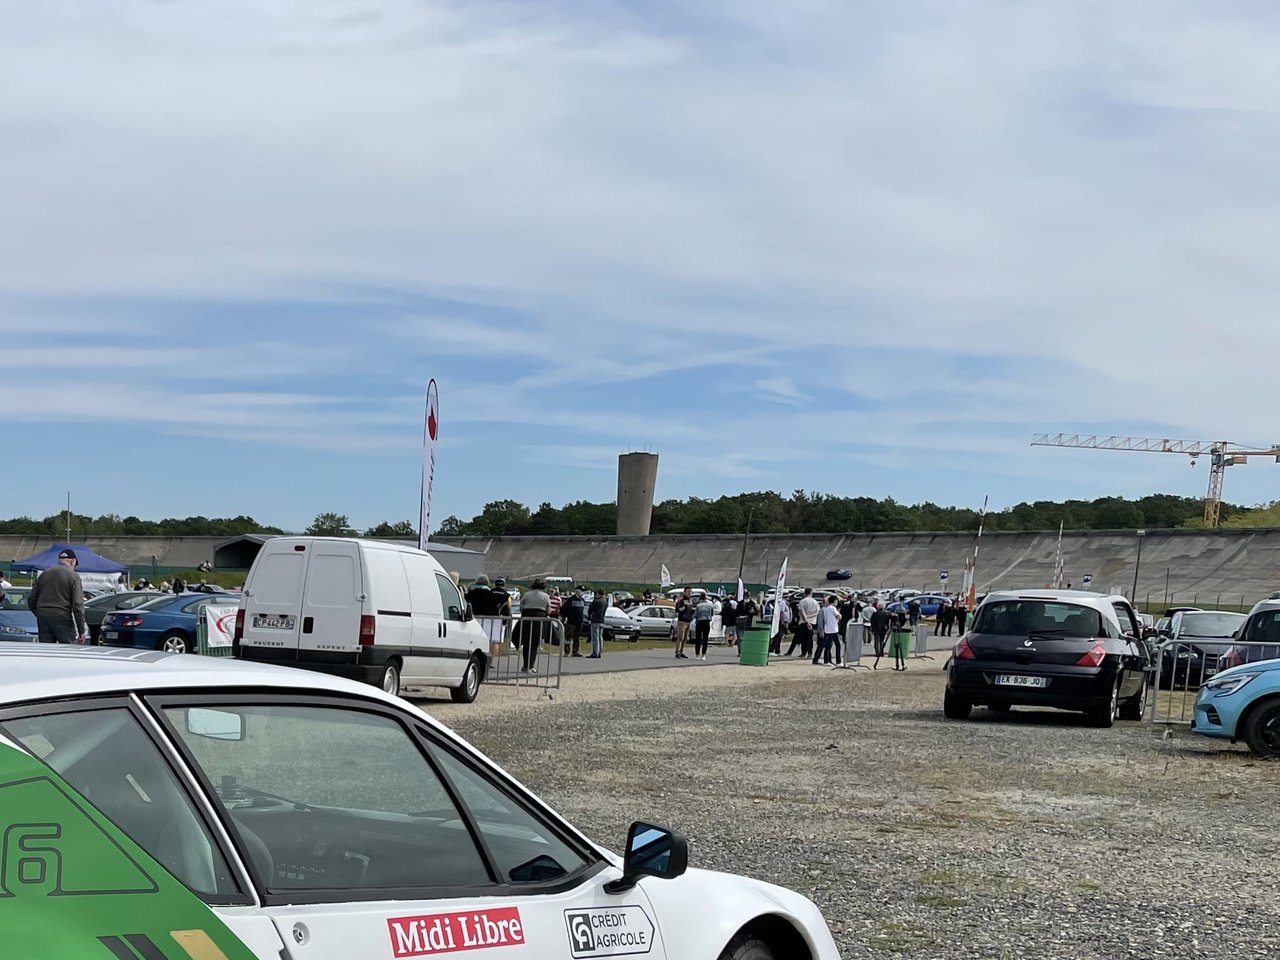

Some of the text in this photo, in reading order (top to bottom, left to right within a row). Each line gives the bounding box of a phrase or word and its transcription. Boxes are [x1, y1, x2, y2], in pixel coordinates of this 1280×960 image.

[591, 911, 627, 928] CRÉDIT
[392, 913, 522, 954] Midi Libre
[596, 931, 646, 948] AGRICOLE
